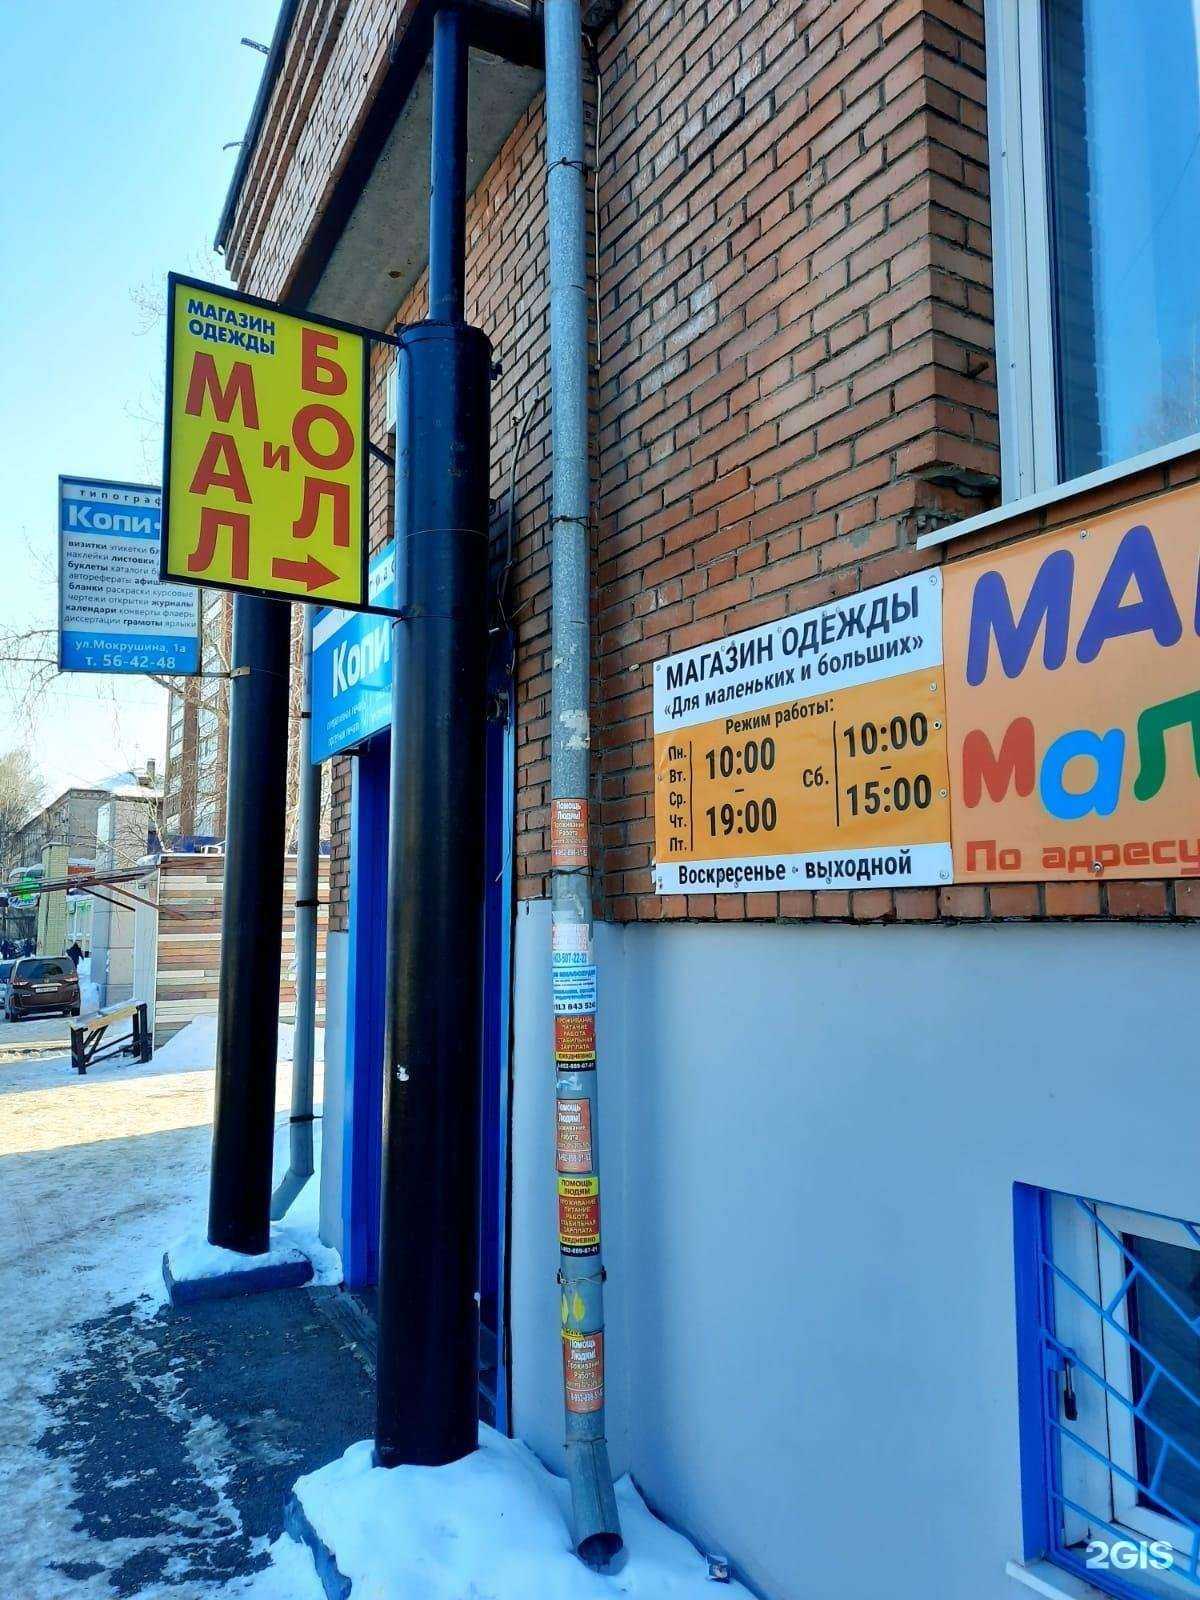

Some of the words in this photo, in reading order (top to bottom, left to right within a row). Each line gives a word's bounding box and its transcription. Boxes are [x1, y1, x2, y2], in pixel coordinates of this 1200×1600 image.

[188, 298, 275, 336] МАГАЗИН
[188, 319, 275, 355] ОДЕЖДЫ
[68, 541, 107, 550] визитки
[67, 561, 109, 571] буклеты
[112, 554, 155, 564] листовки
[68, 582, 104, 592] бланки
[151, 600, 194, 609] журналы
[123, 618, 163, 628] грамоты
[666, 633, 773, 690] МАГАЗИН
[781, 586, 919, 656] ОДЕЖДЫ
[103, 654, 176, 669] 56-42-48
[664, 695, 700, 719] «Для
[705, 666, 795, 707] маленьких
[801, 664, 812, 681] и
[817, 634, 924, 677] больших»
[725, 713, 771, 735] Режим
[775, 698, 834, 728] работы:
[843, 712, 928, 758] 10:00
[668, 746, 687, 761] Пн.
[705, 737, 775, 780] 10:00
[669, 769, 687, 783] Вт.
[802, 766, 829, 788] Сб.
[669, 791, 687, 808] Ср.
[846, 774, 932, 816] 15:00
[669, 815, 687, 829] Чт.
[706, 797, 777, 837] 19:00
[669, 837, 687, 852] Пт.
[966, 840, 1021, 872] По
[678, 864, 786, 888] Воскресенье
[805, 849, 911, 881] выходной
